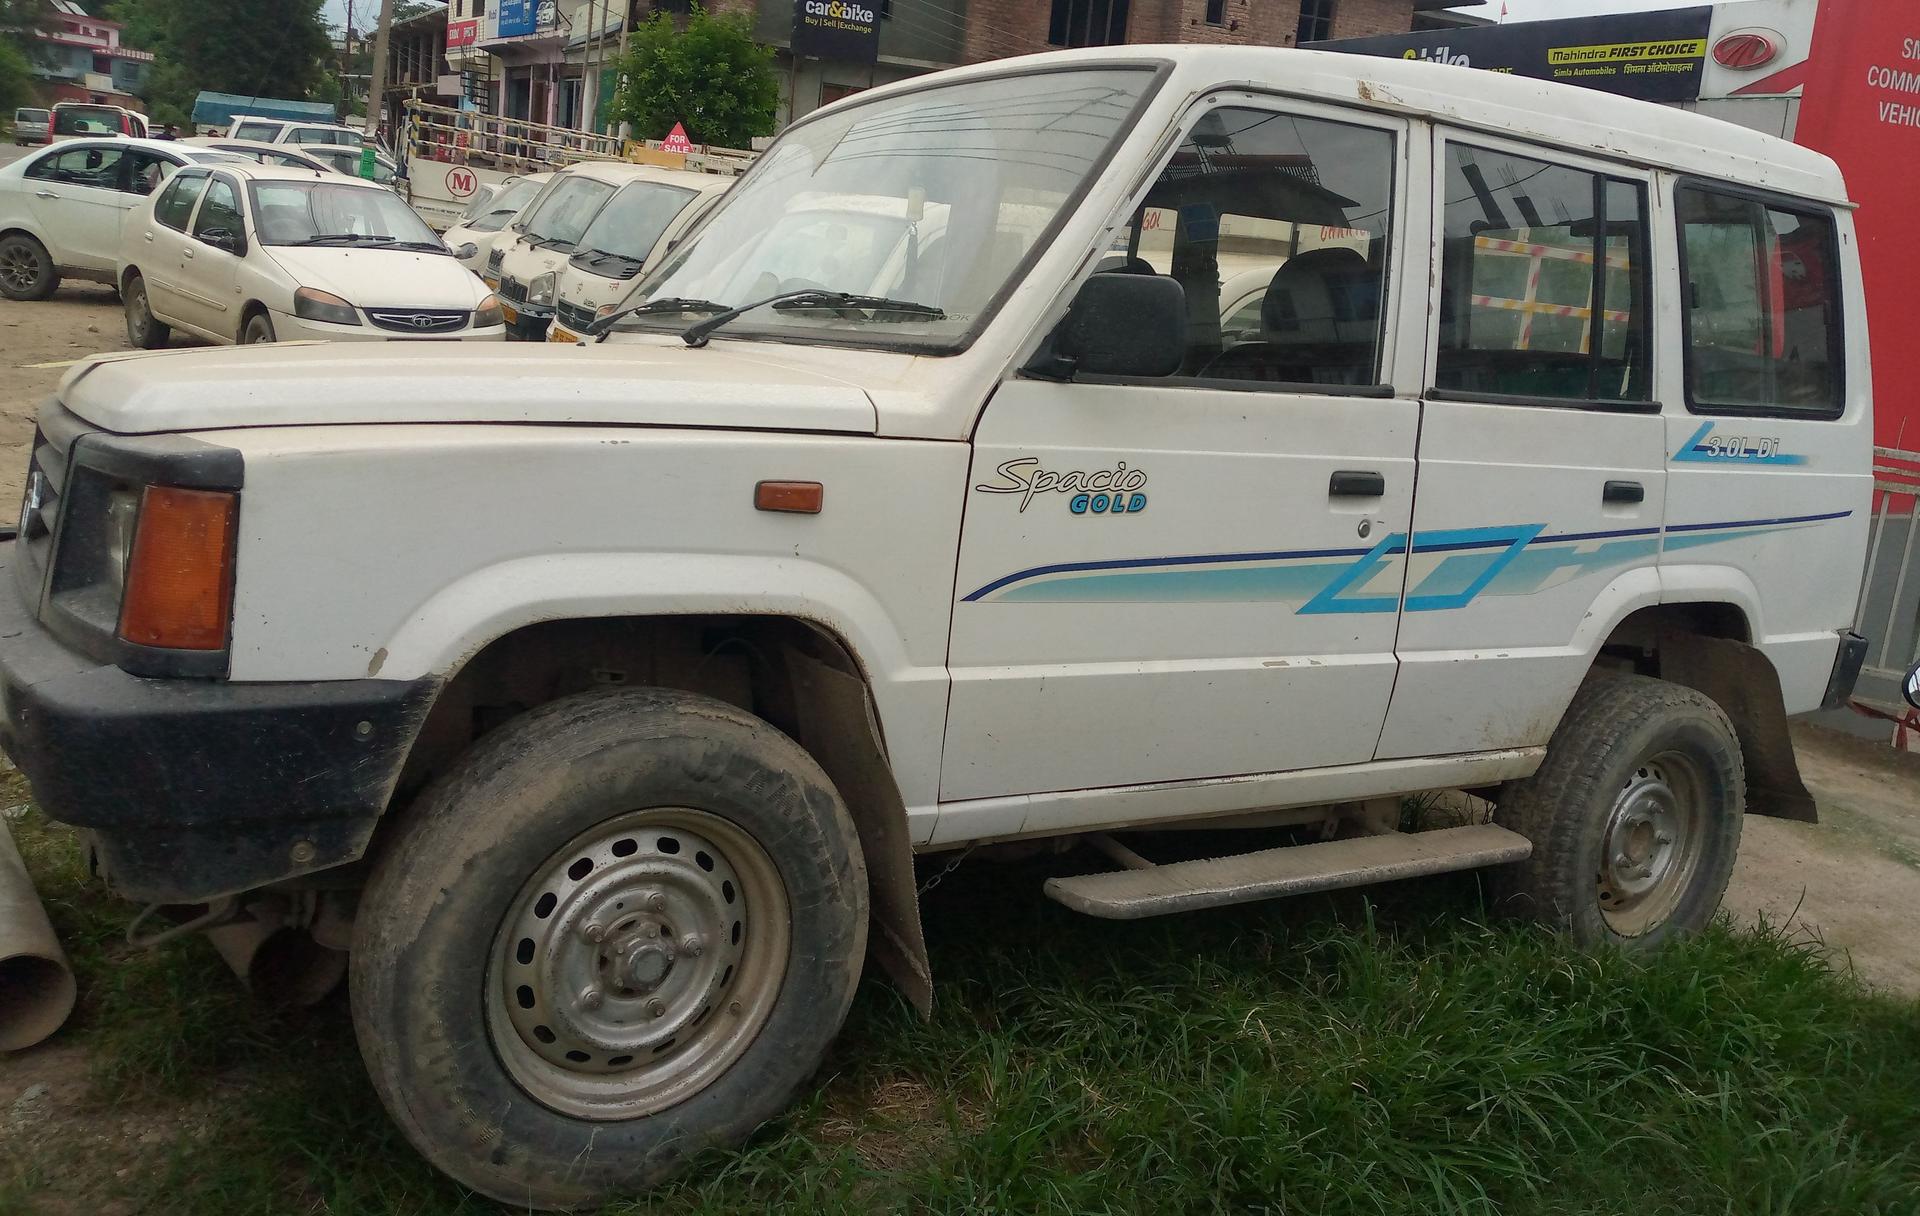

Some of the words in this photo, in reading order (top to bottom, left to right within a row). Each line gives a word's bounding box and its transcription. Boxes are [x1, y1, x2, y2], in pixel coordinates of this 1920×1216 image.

[805, 0, 874, 23] car&bike
[805, 16, 819, 26] Buy
[823, 19, 837, 28] Sell
[1552, 50, 1607, 61] Mahindra
[1609, 47, 1648, 58] FIRST
[1648, 43, 1698, 56] CHOICE
[1554, 67, 1573, 77] Simla
[1573, 66, 1617, 76] Automobiles
[669, 134, 686, 144] FOR
[664, 144, 690, 154] SALE
[451, 172, 472, 192] M
[975, 456, 1148, 514] Spacio
[1069, 492, 1148, 514] GOLD
